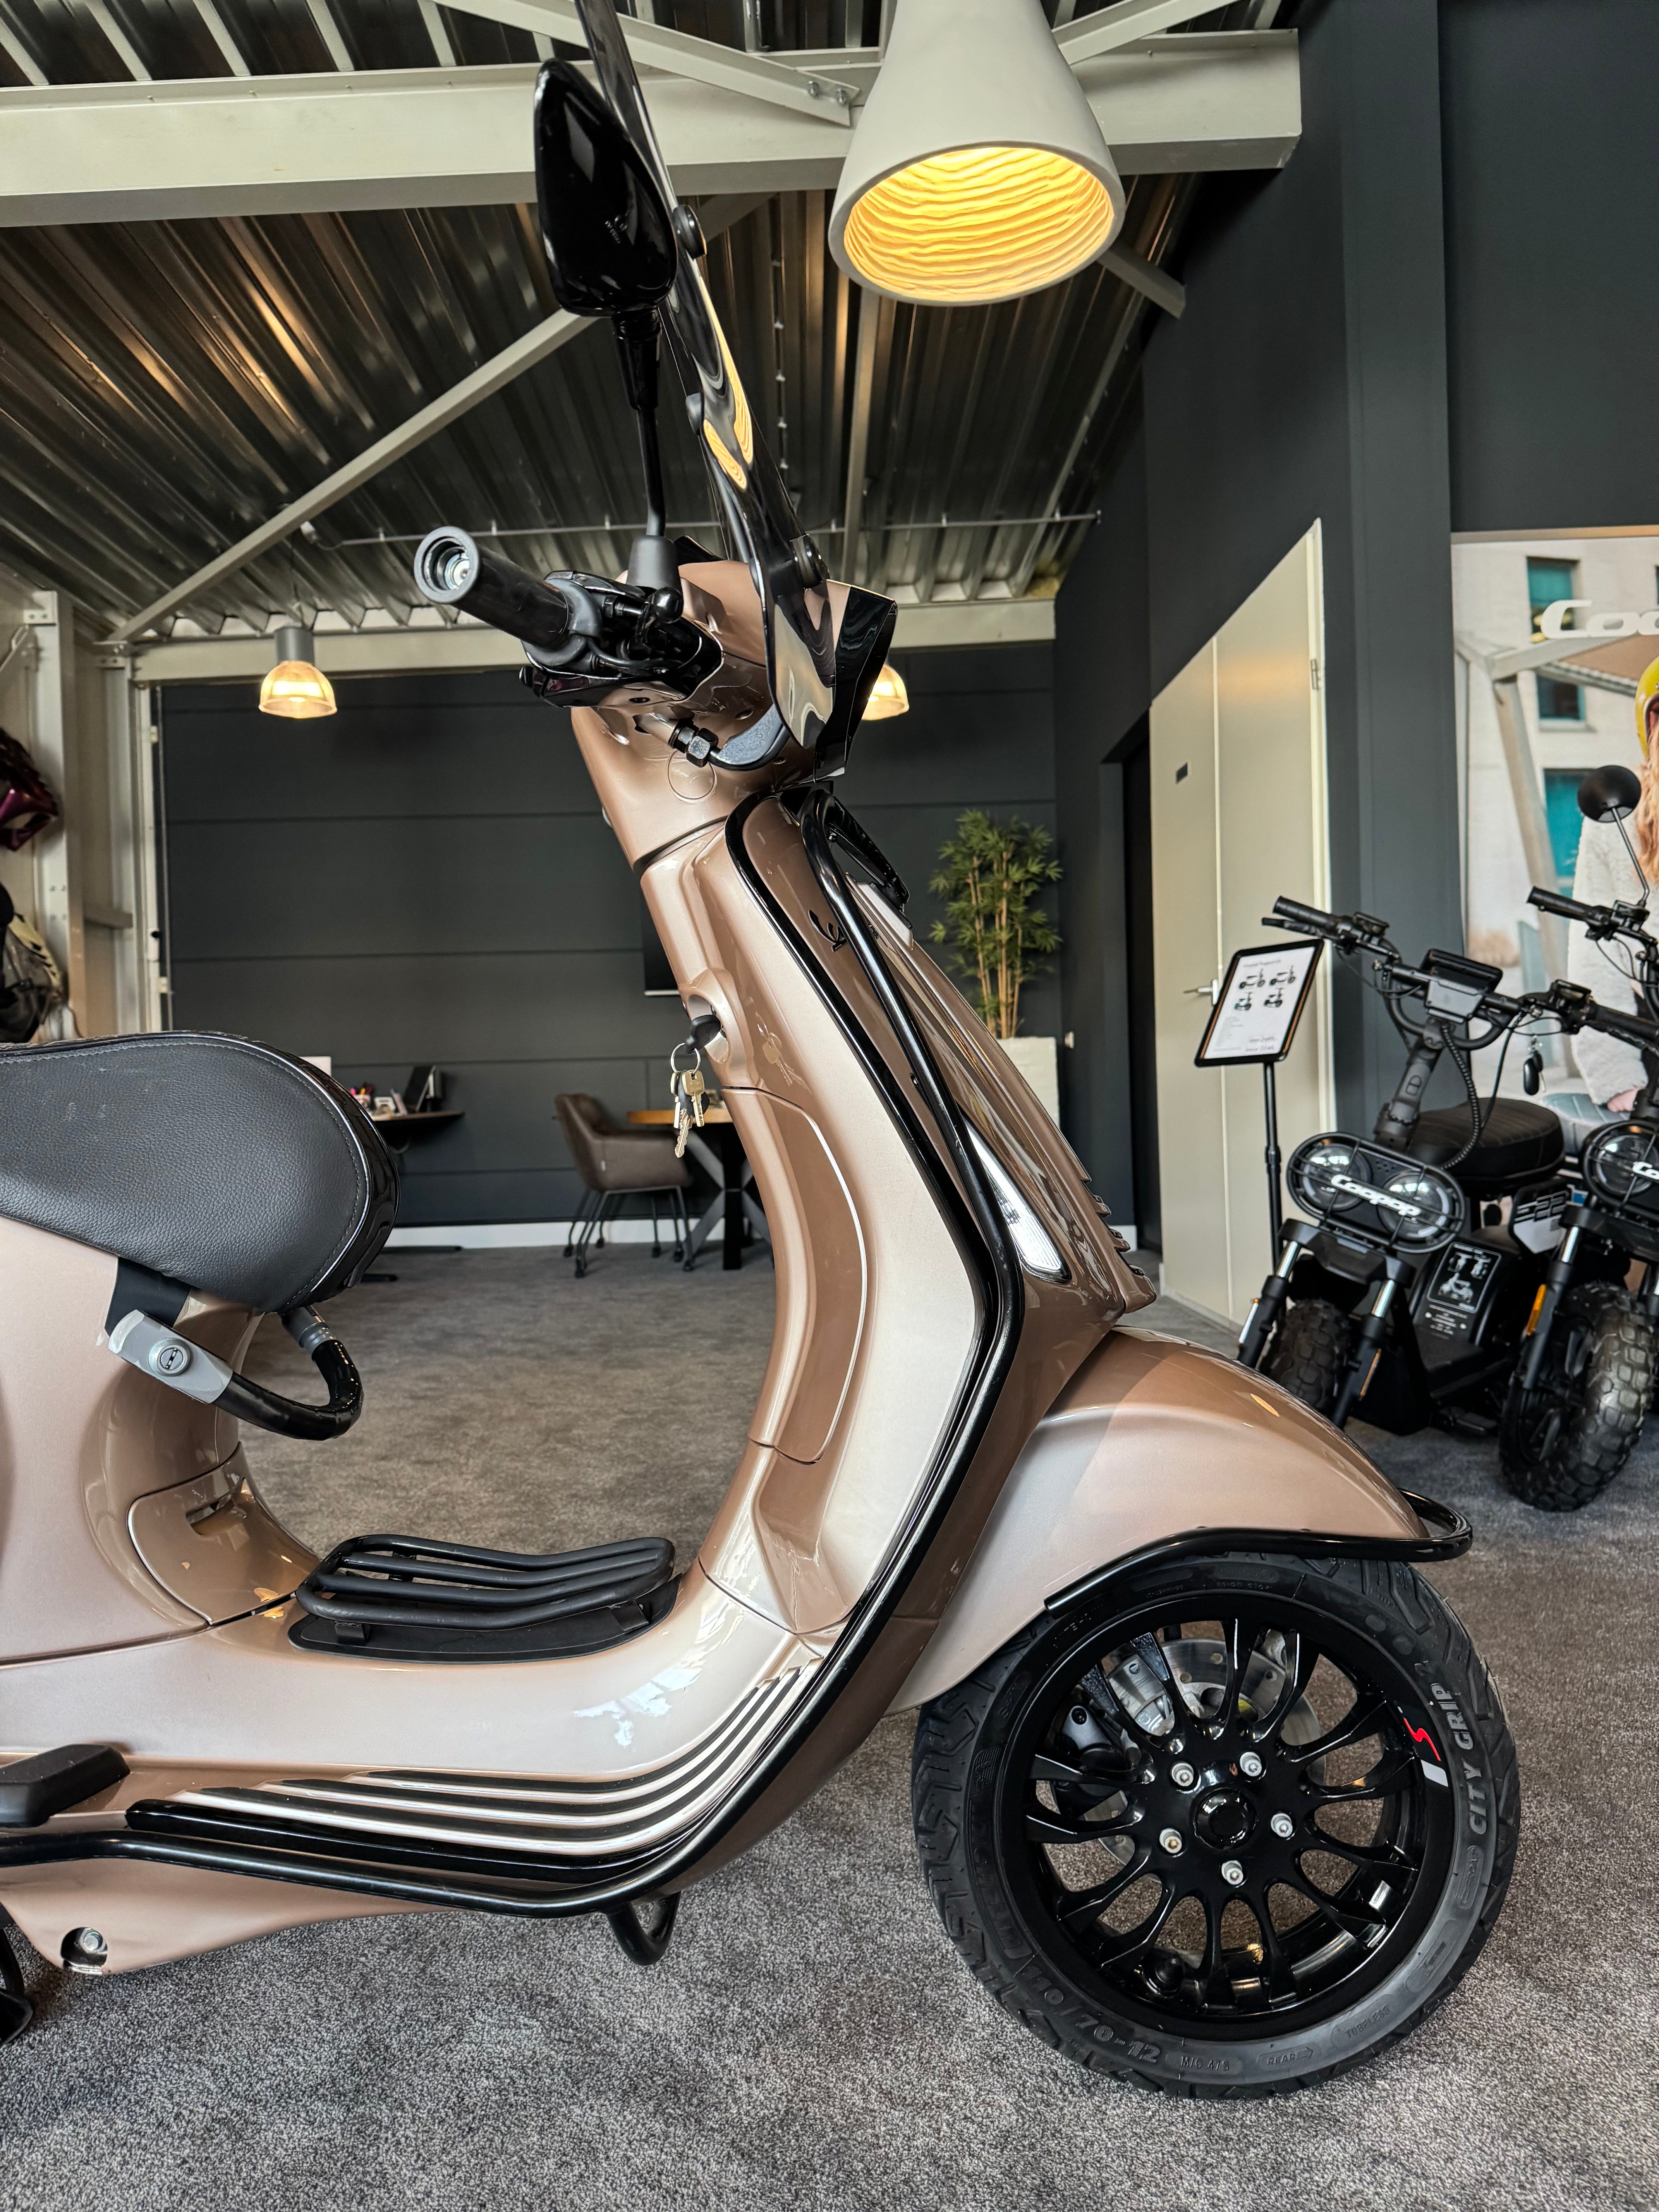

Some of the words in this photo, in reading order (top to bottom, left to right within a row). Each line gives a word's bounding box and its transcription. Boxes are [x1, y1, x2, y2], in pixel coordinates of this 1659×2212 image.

[1431, 1683, 1474, 1750] GRIP
[1462, 1758, 1487, 1835] CITY
[1181, 2056, 1203, 2069] M/C
